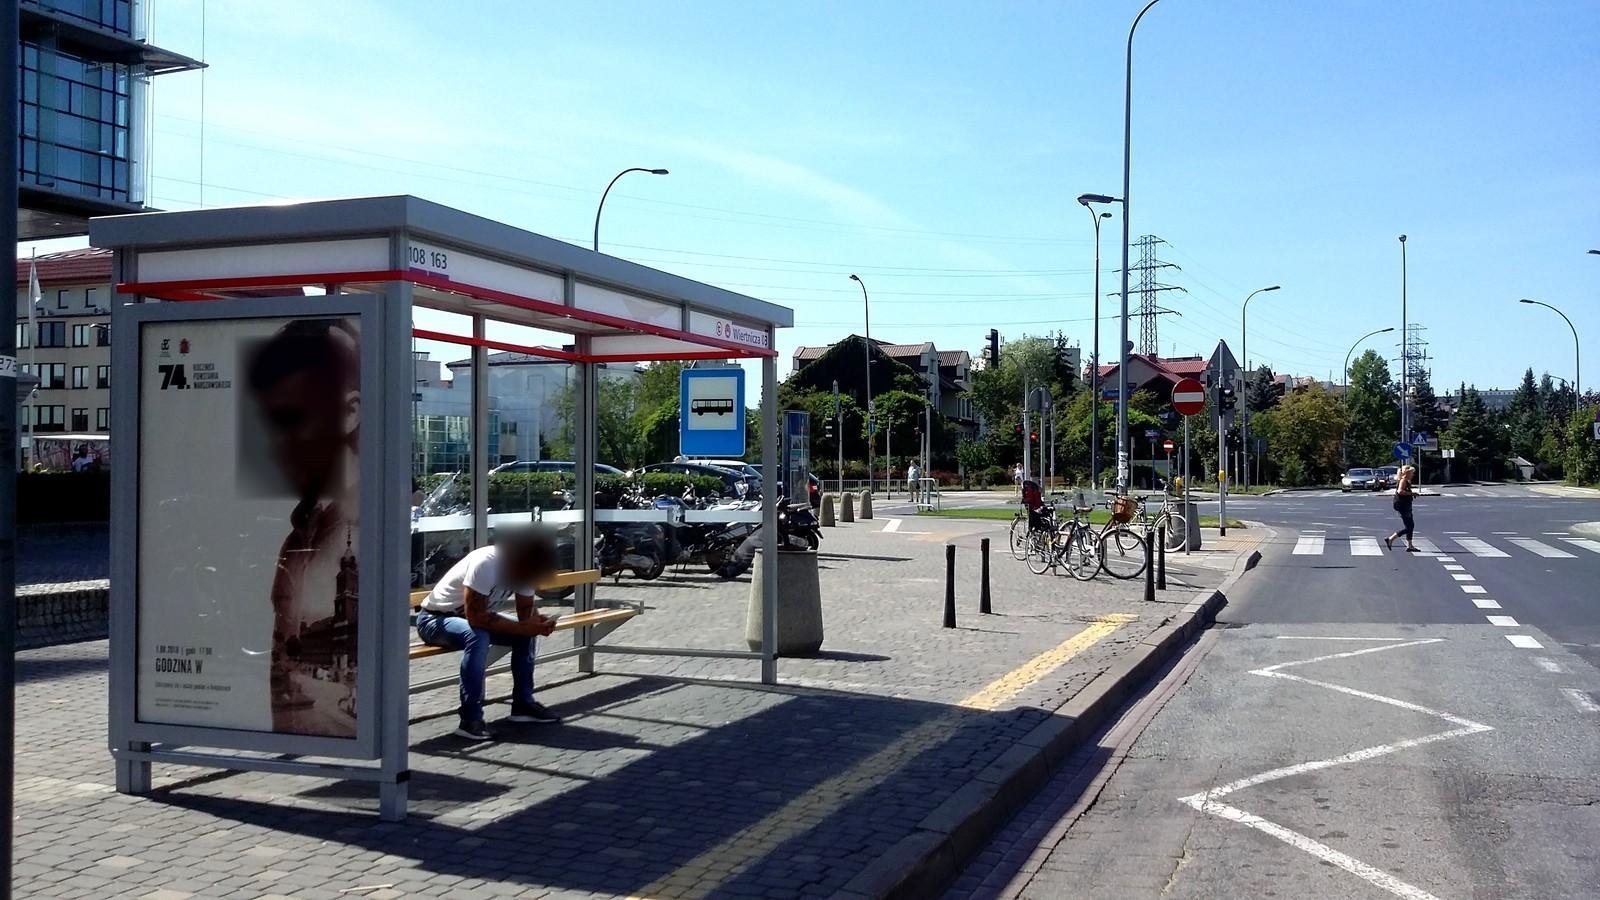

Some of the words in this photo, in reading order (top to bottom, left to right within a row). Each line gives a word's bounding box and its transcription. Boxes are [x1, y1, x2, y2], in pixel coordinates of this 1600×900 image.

[409, 246, 426, 265] 108
[431, 251, 447, 270] 163
[158, 364, 191, 390] 74.
[155, 657, 192, 673] GODZINA
[194, 659, 204, 674] W
